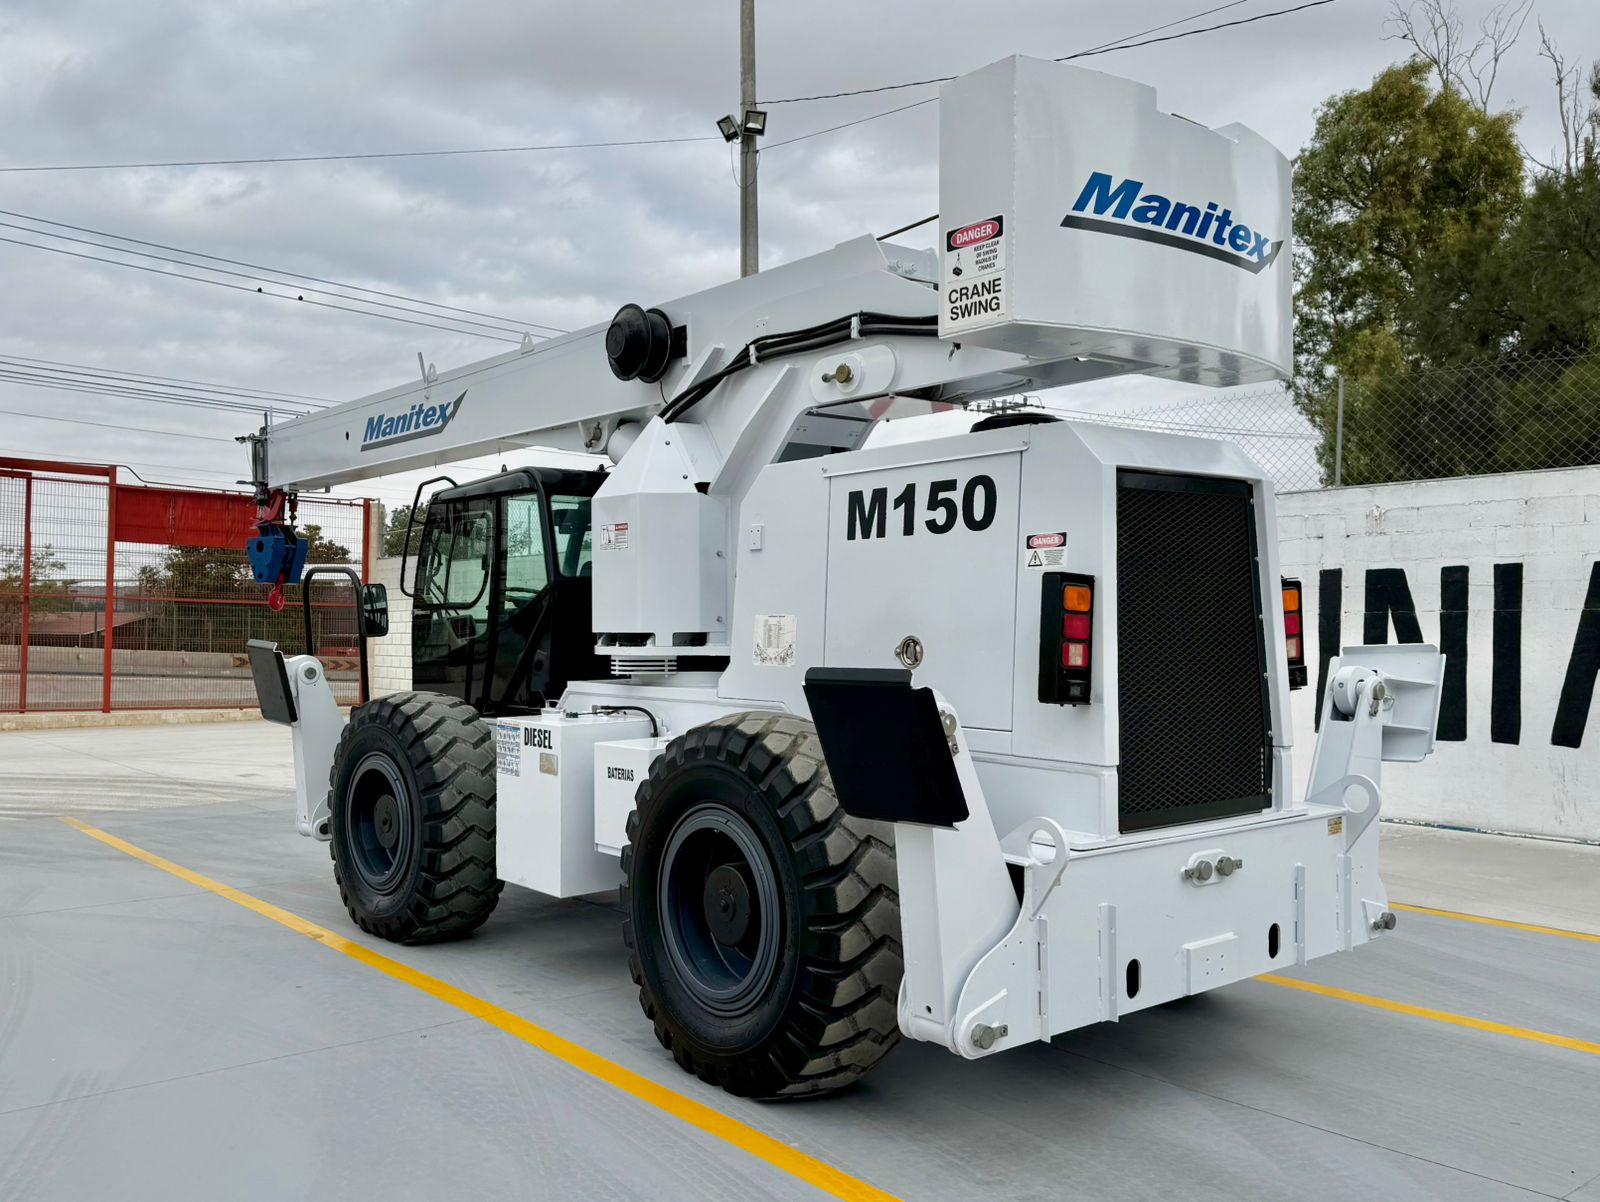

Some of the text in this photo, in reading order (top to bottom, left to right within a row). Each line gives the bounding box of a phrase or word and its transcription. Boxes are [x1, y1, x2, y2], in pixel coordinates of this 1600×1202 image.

[1071, 171, 1270, 262] Manitex
[956, 224, 993, 245] DANGER
[974, 239, 1000, 252] KEEP CLEAR
[975, 256, 992, 265] RADIUS
[982, 247, 998, 256] SWING
[948, 277, 1002, 304] CRANE
[950, 296, 1001, 321] SWING
[363, 401, 452, 442] Manitex
[847, 474, 998, 541] M150
[1033, 536, 1060, 546] DANGER
[524, 726, 553, 750] DIESEL
[607, 766, 635, 782] BATERIAS
